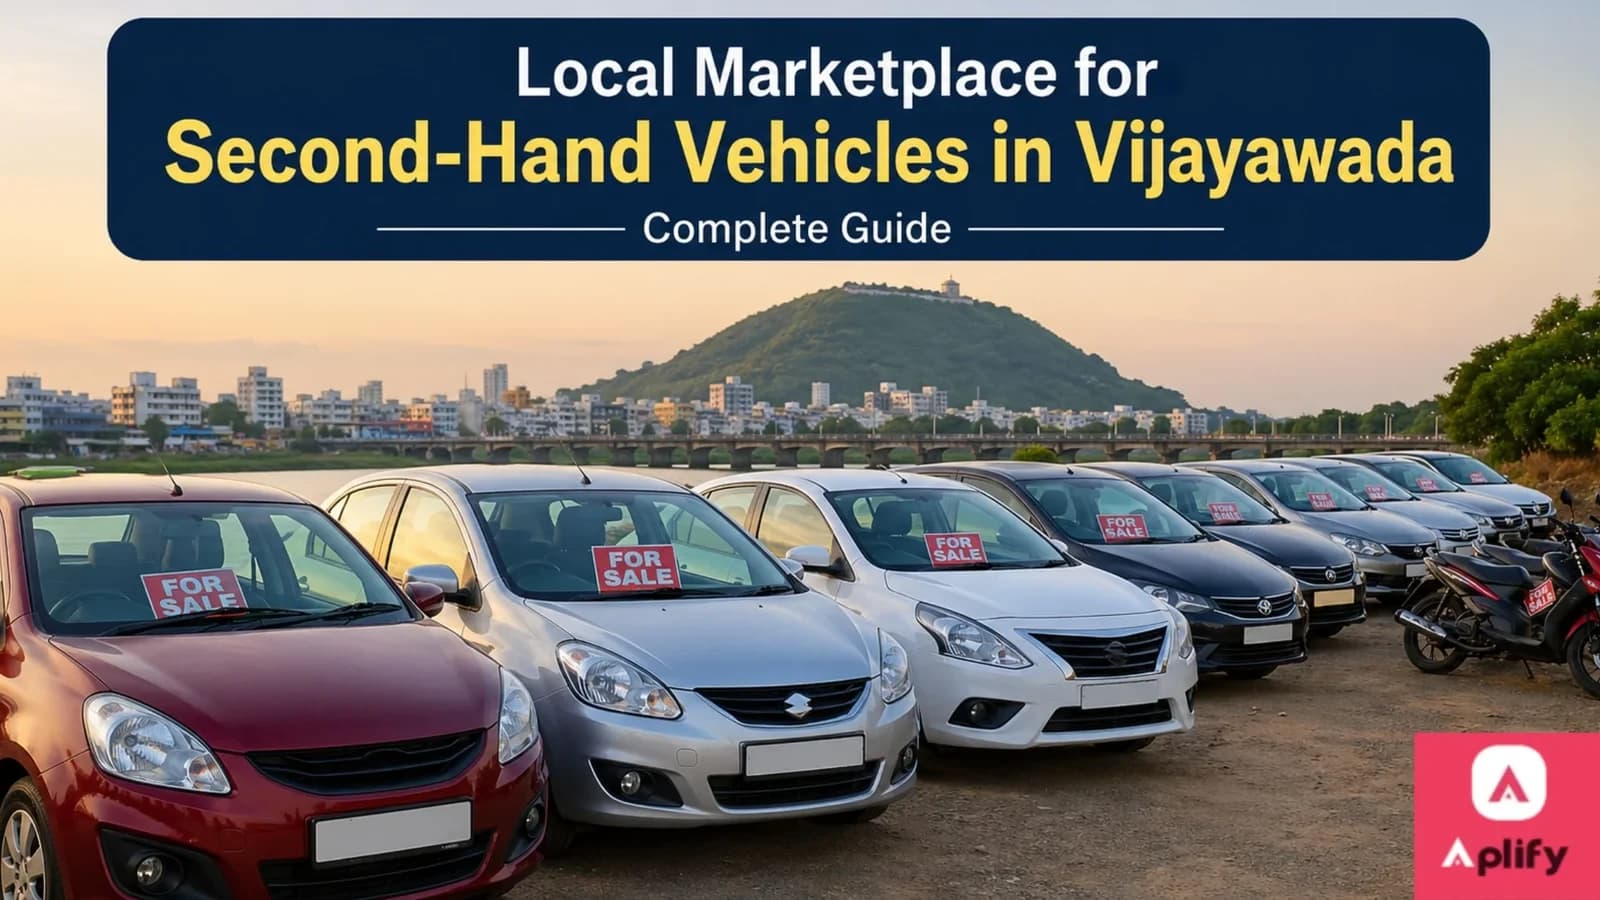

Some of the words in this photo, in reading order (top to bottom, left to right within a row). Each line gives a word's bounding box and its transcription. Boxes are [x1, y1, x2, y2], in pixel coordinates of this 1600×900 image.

[1106, 517, 1137, 529] FOR
[1105, 527, 1145, 538] SALE
[936, 537, 972, 549] FOR
[608, 551, 662, 568] FOR
[934, 549, 982, 562] SALE
[604, 568, 674, 587] SALE
[161, 575, 224, 597] FOR
[160, 593, 240, 617] SALE
